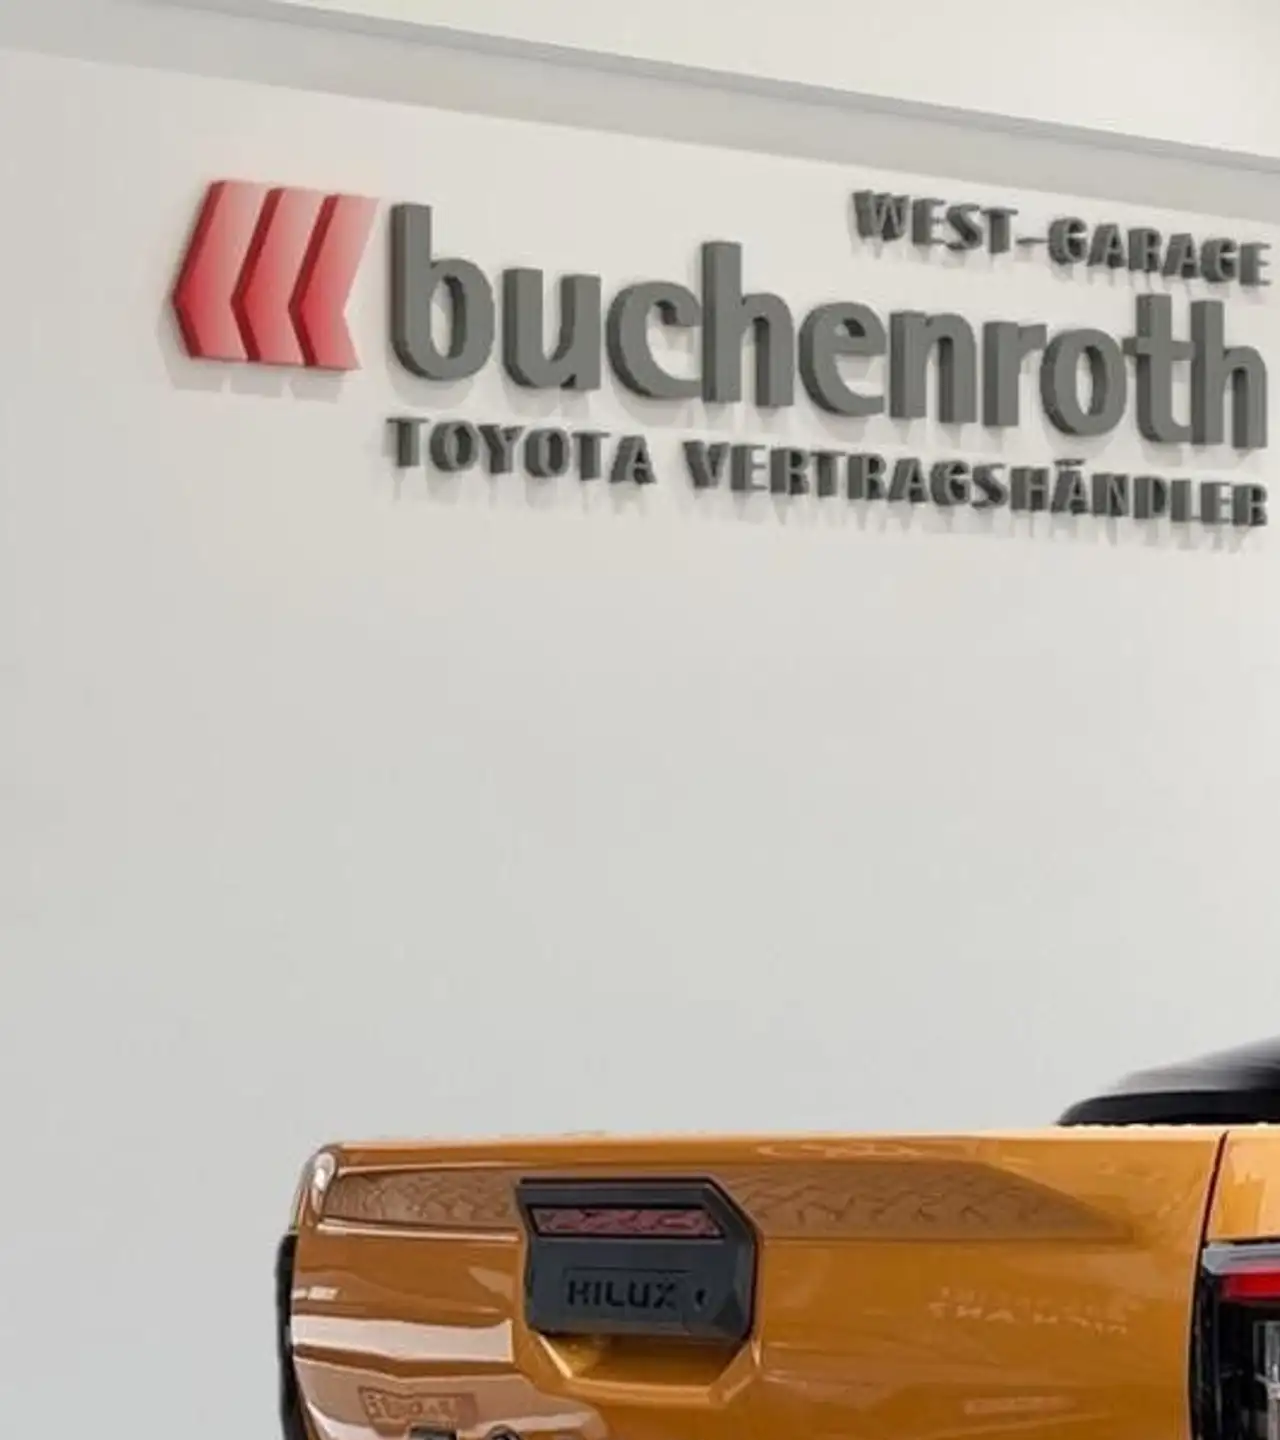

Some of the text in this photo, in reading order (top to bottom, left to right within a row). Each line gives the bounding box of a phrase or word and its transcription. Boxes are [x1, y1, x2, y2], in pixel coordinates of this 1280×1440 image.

[852, 190, 1271, 286] WEST-GARAGE
[390, 202, 1268, 448] buchenroth
[386, 417, 1268, 527] TOYOTA VERTRAGSHÄNDLER
[567, 1279, 678, 1311] HILUX
